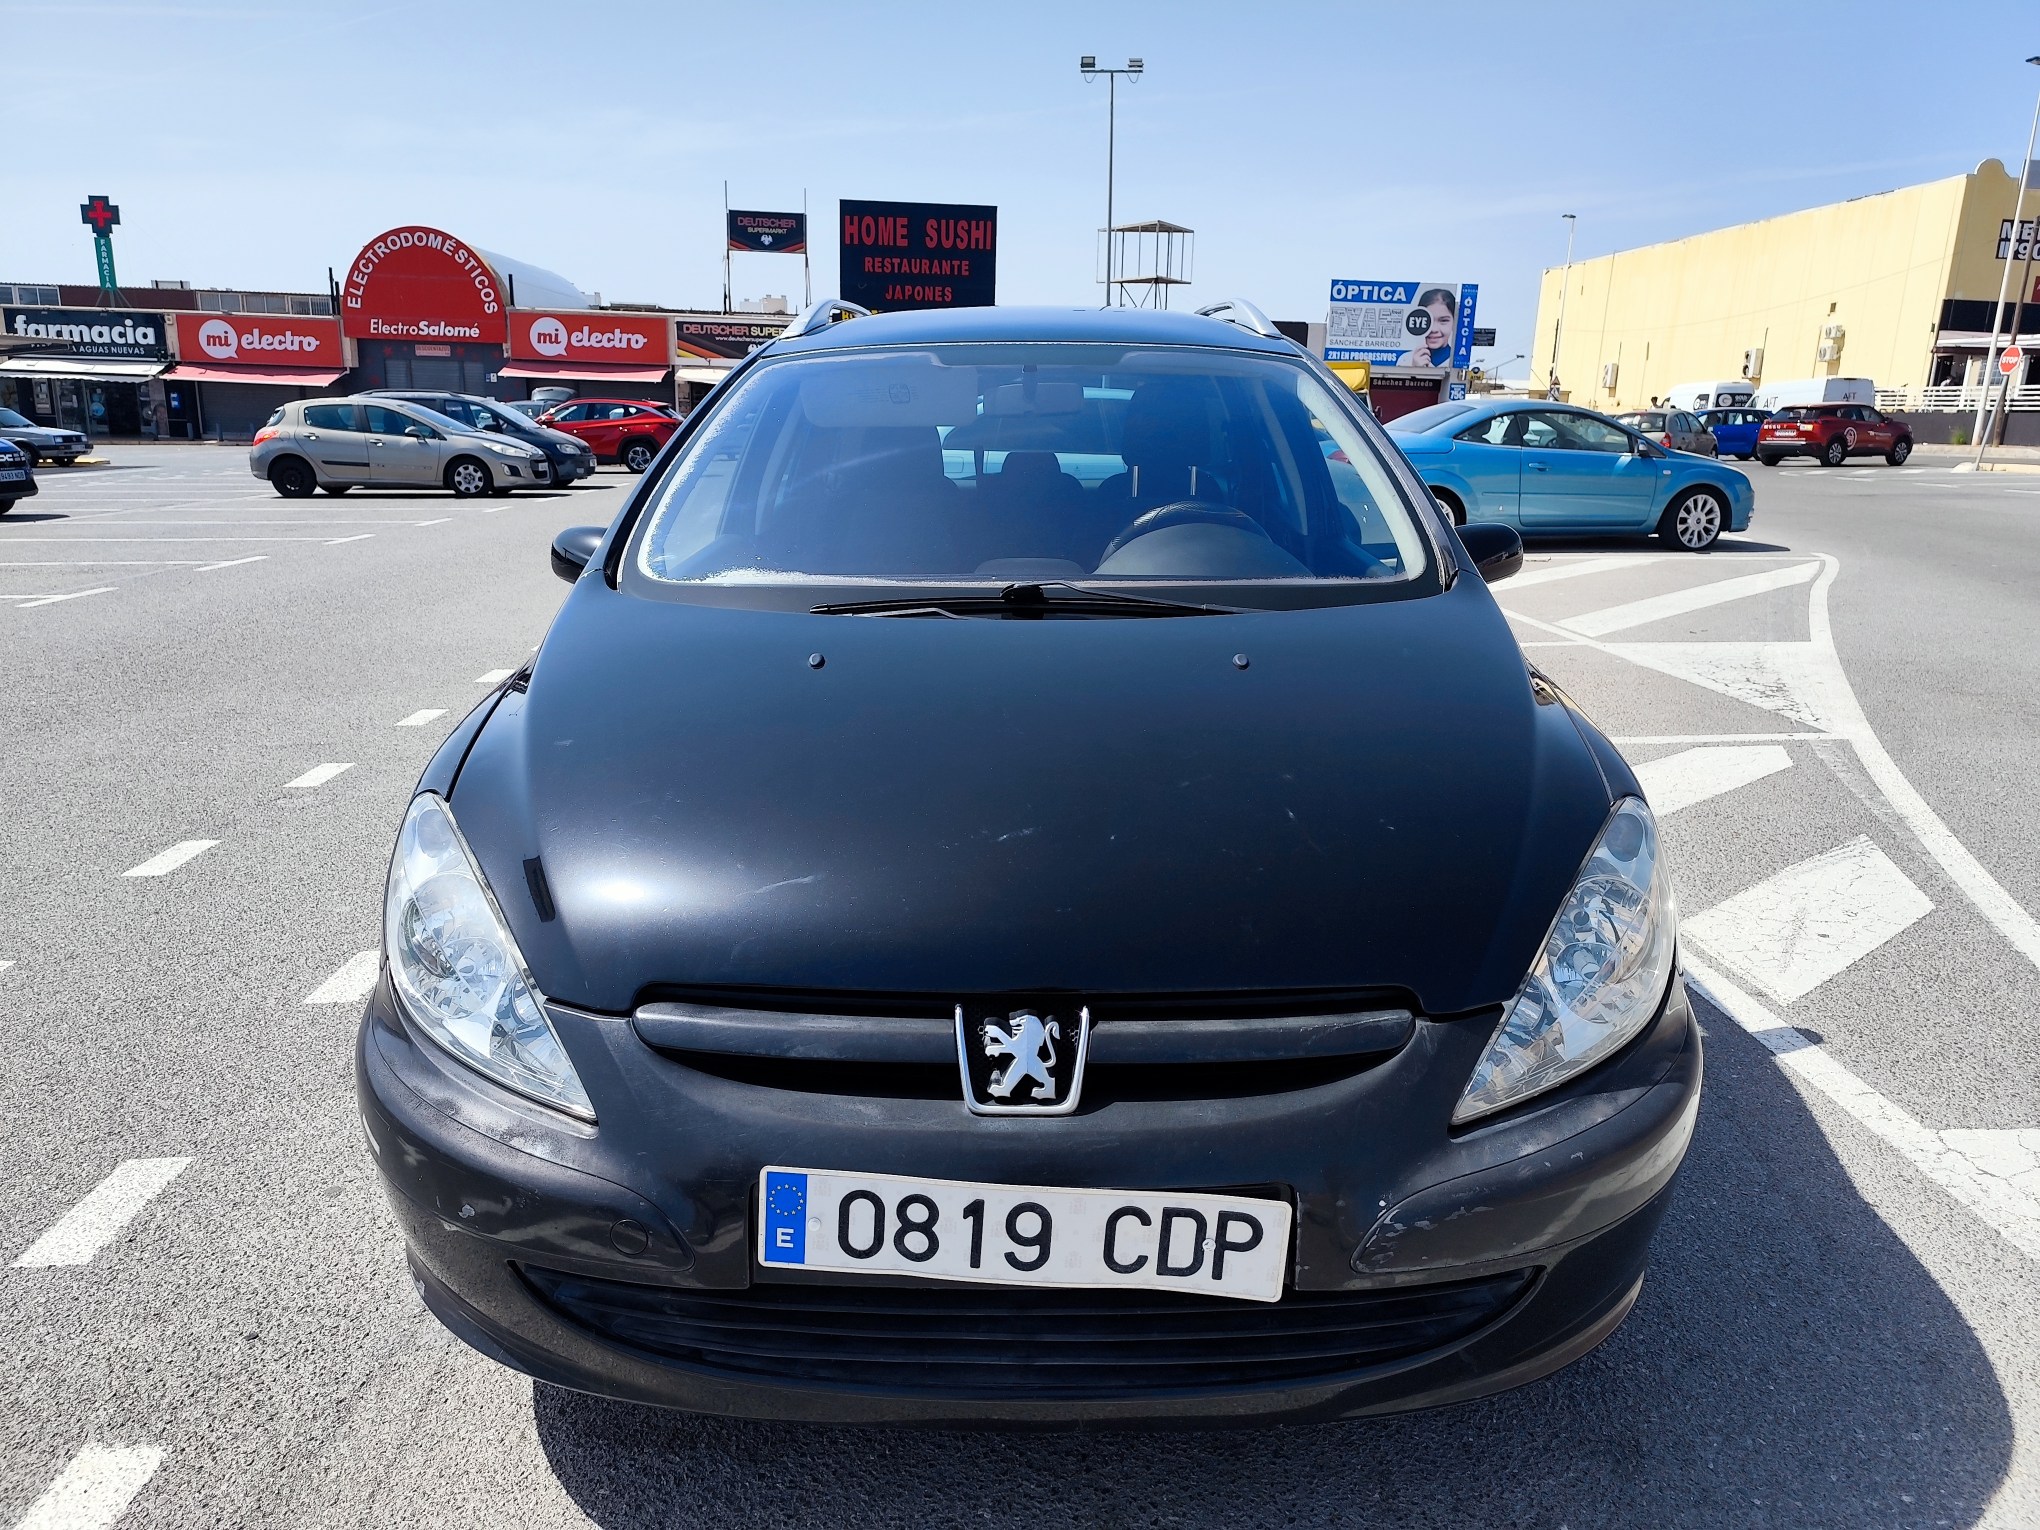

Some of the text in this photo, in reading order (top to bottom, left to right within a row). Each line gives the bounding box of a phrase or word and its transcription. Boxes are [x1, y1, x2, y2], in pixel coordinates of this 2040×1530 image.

[737, 216, 796, 228] DEUTSCHER
[844, 215, 993, 250] HOME SUSHI
[100, 239, 112, 288] FARMACIA
[347, 231, 498, 314] ELECTRODOMÉSTICOS
[864, 256, 969, 276] RESTAURANTE
[885, 285, 953, 302] JAPONES
[1332, 282, 1407, 301] ÓPTICA
[14, 315, 155, 345] farmacia
[370, 318, 480, 337] ElectroSalomé
[683, 324, 749, 335] DEUTSCHER
[1408, 316, 1428, 328] EYE
[206, 328, 320, 352] mi electro
[537, 326, 648, 349] mi electro
[1365, 340, 1401, 348] BARREDO
[79, 346, 109, 354] AGUAS
[111, 346, 145, 355] NUEVAS
[1327, 351, 1397, 362] 2X1 EN PROGRESIVOS
[1405, 379, 1433, 387] Barredo
[776, 1189, 1264, 1281] E 0819 CDP
